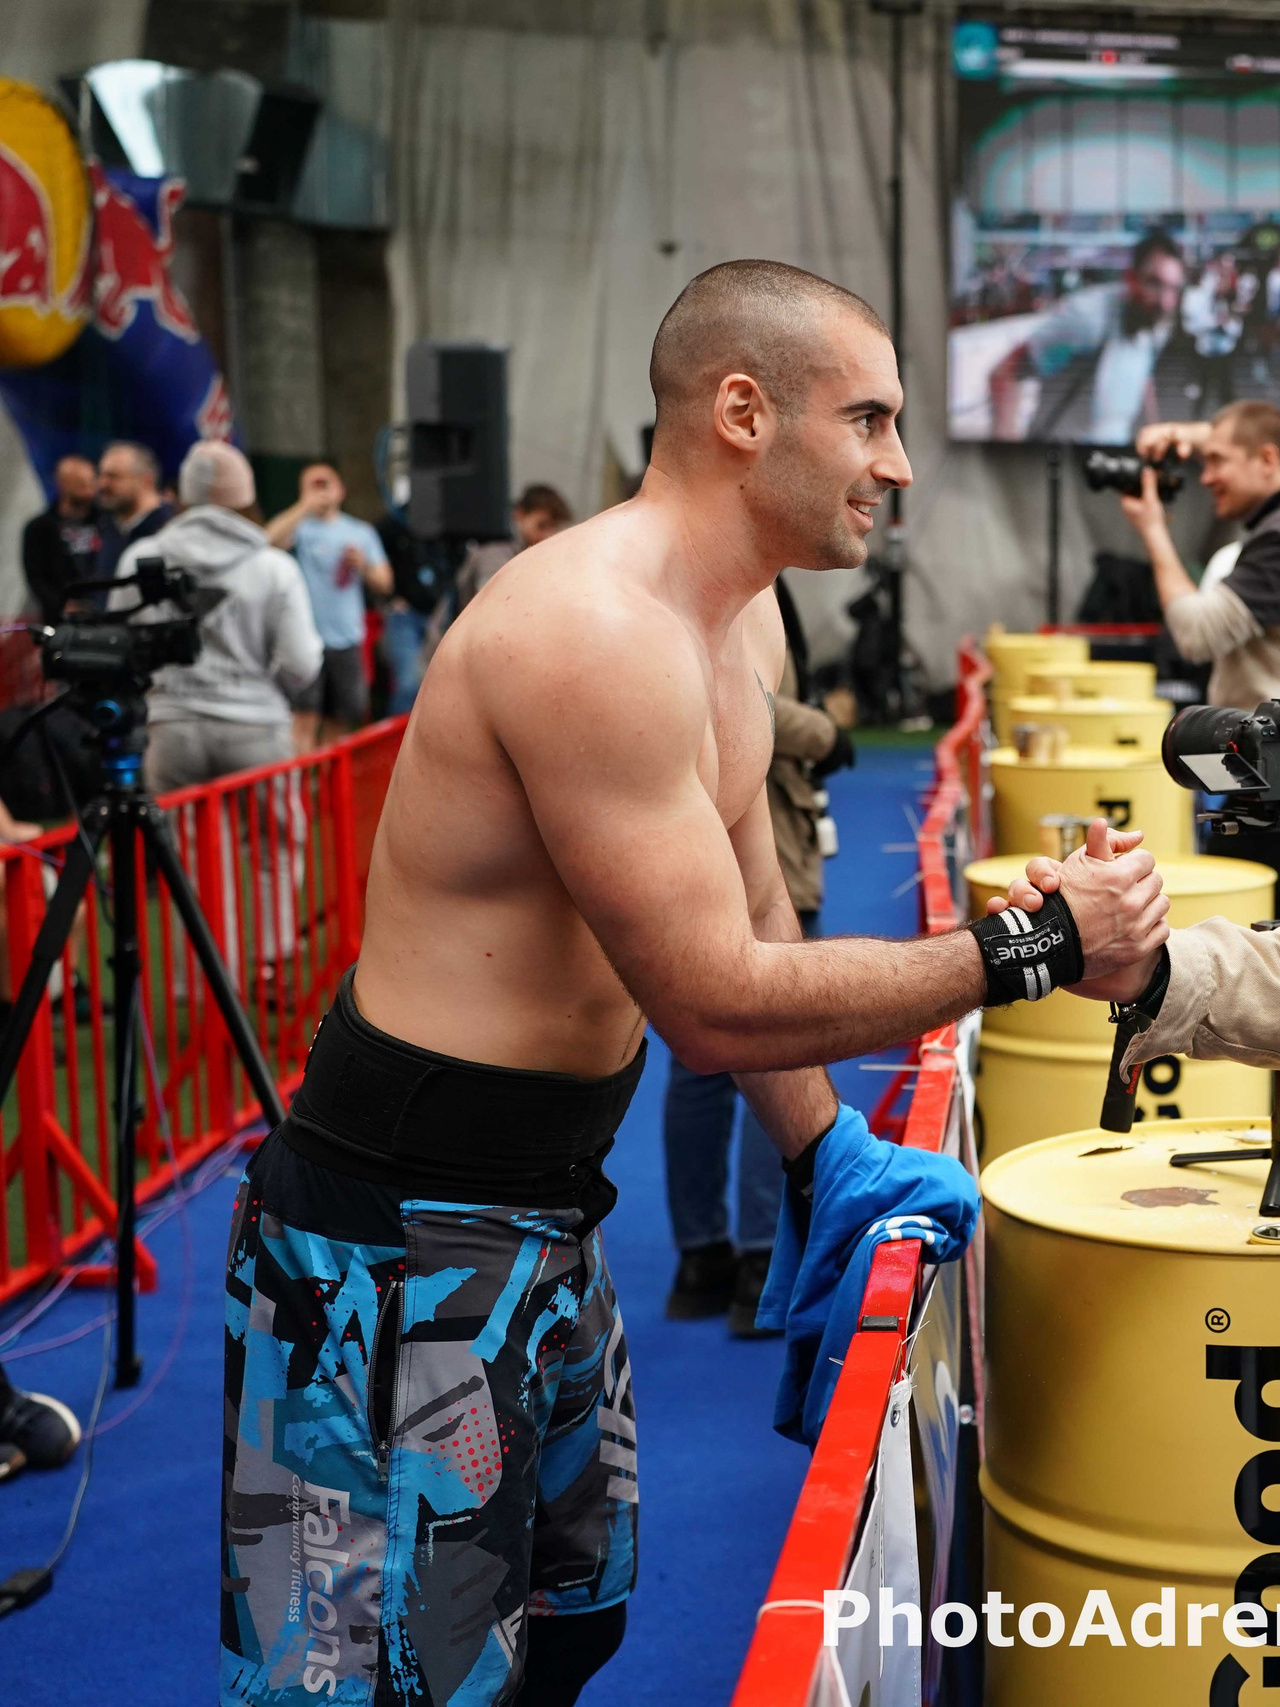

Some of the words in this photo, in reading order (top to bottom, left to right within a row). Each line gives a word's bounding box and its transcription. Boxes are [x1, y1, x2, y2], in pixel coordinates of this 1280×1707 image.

[288, 1473, 302, 1567] Community
[288, 1568, 303, 1623] fitness
[302, 1480, 351, 1697] Falcons
